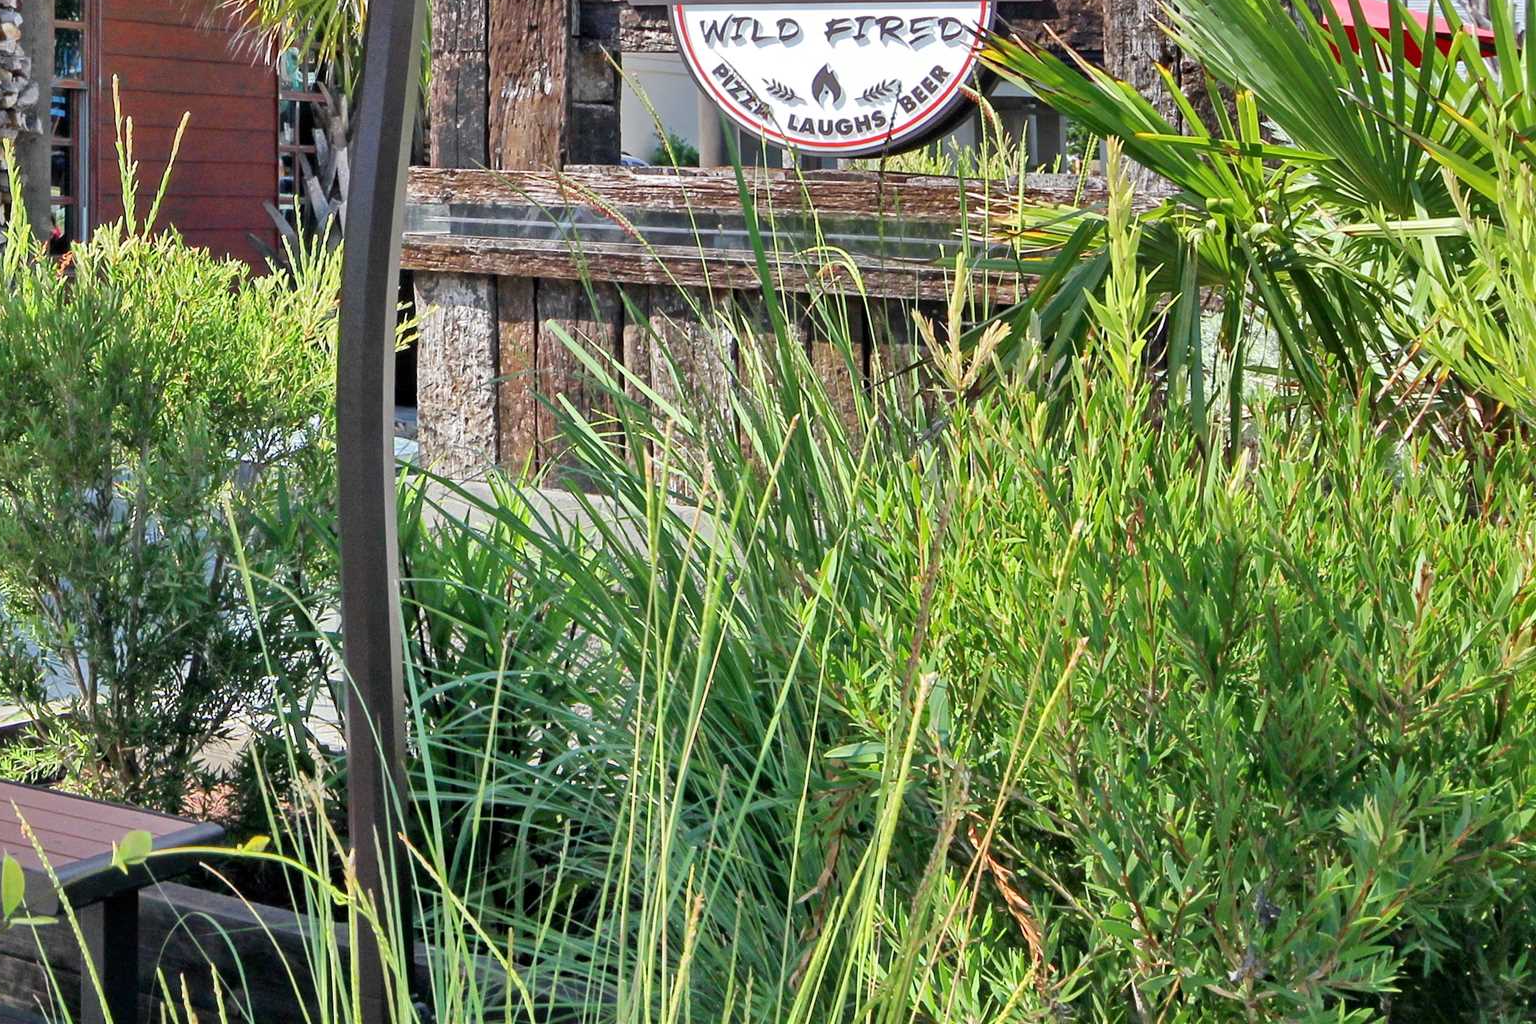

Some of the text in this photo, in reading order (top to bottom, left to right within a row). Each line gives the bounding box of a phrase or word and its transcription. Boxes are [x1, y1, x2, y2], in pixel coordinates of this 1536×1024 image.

[699, 14, 963, 50] WILD FIRED
[711, 62, 951, 136] PIZZA LAUGHS BEER
